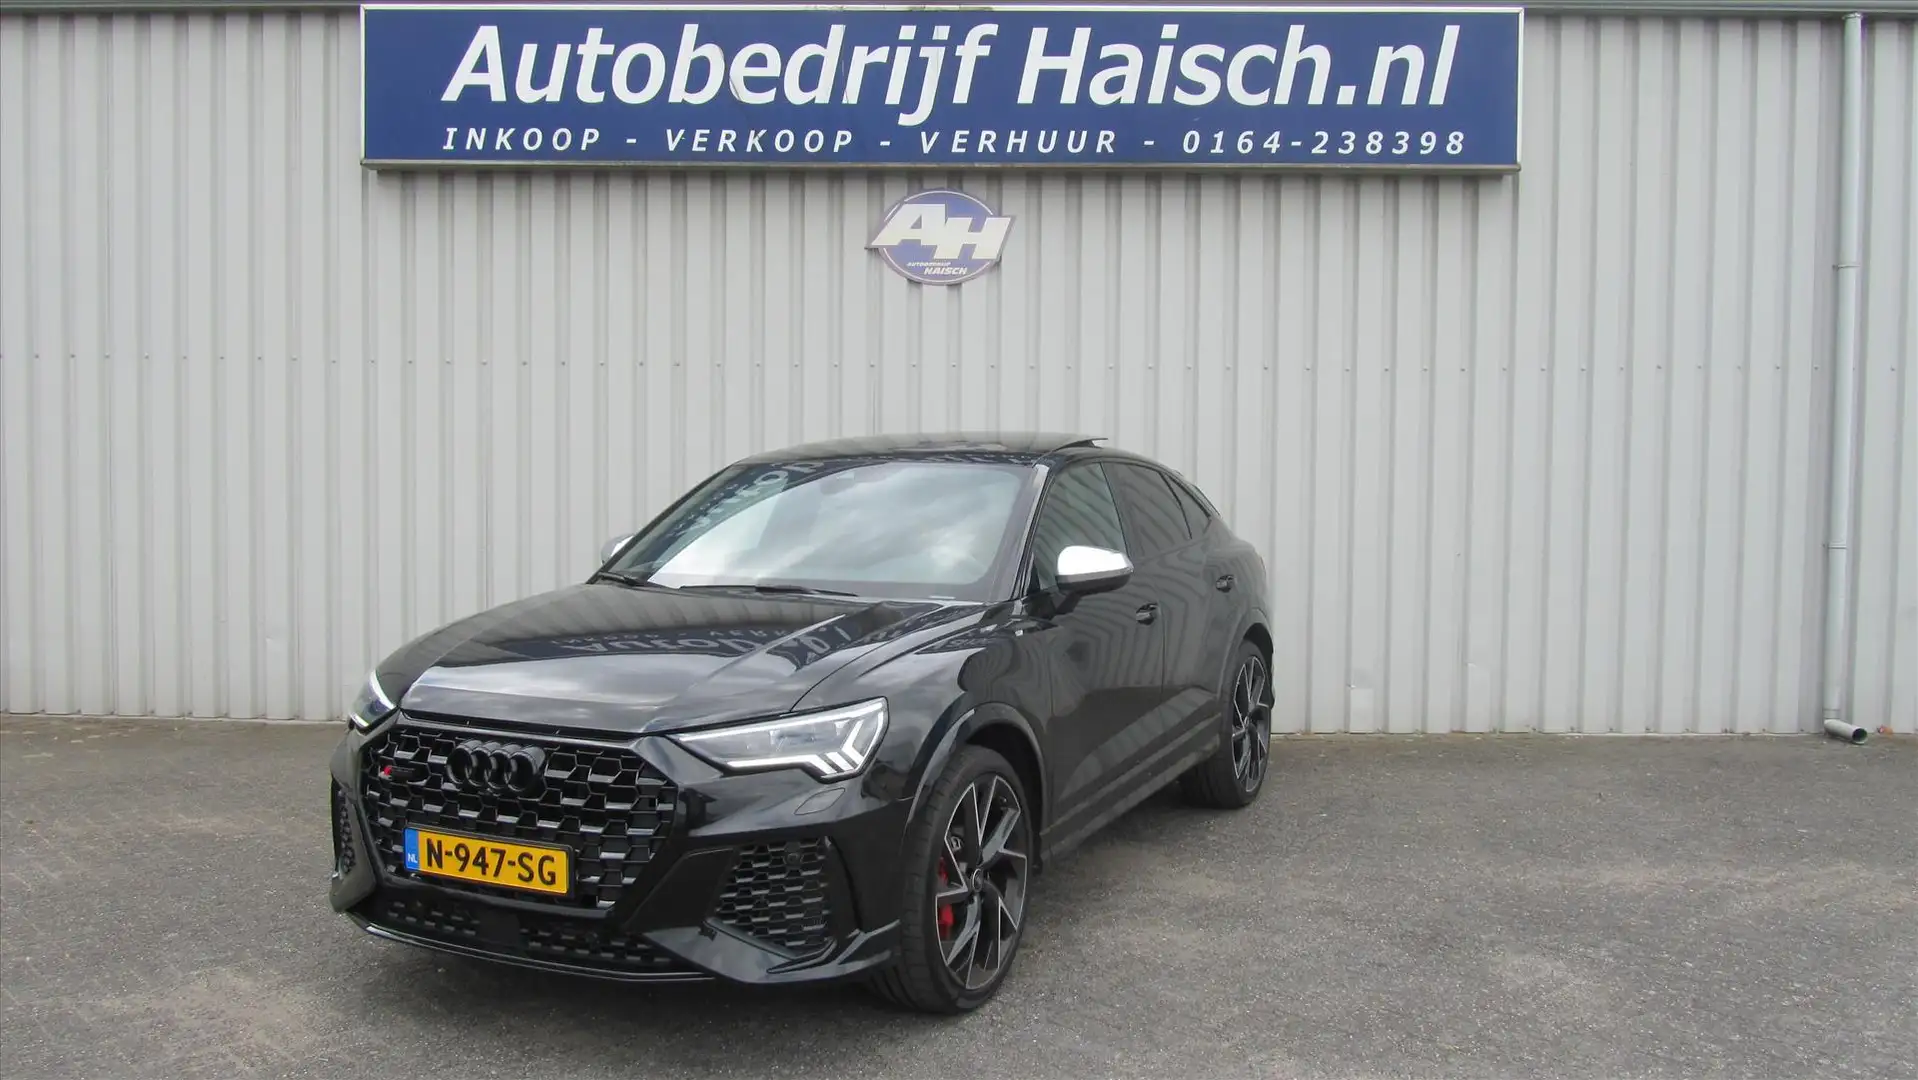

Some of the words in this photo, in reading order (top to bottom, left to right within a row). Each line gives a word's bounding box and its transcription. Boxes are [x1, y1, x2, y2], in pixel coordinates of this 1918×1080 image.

[441, 23, 999, 127] Autobedrijf
[1017, 23, 1461, 106] Haisch.nl
[443, 127, 601, 151] INKOOP
[666, 128, 852, 153] VERKOOP
[920, 130, 1116, 154] VERHUUR
[1182, 130, 1465, 155] 0164-238398
[870, 203, 1012, 260] AH
[923, 267, 968, 275] HAISCH
[407, 853, 418, 864] NL
[426, 837, 557, 886] N-947-SG
